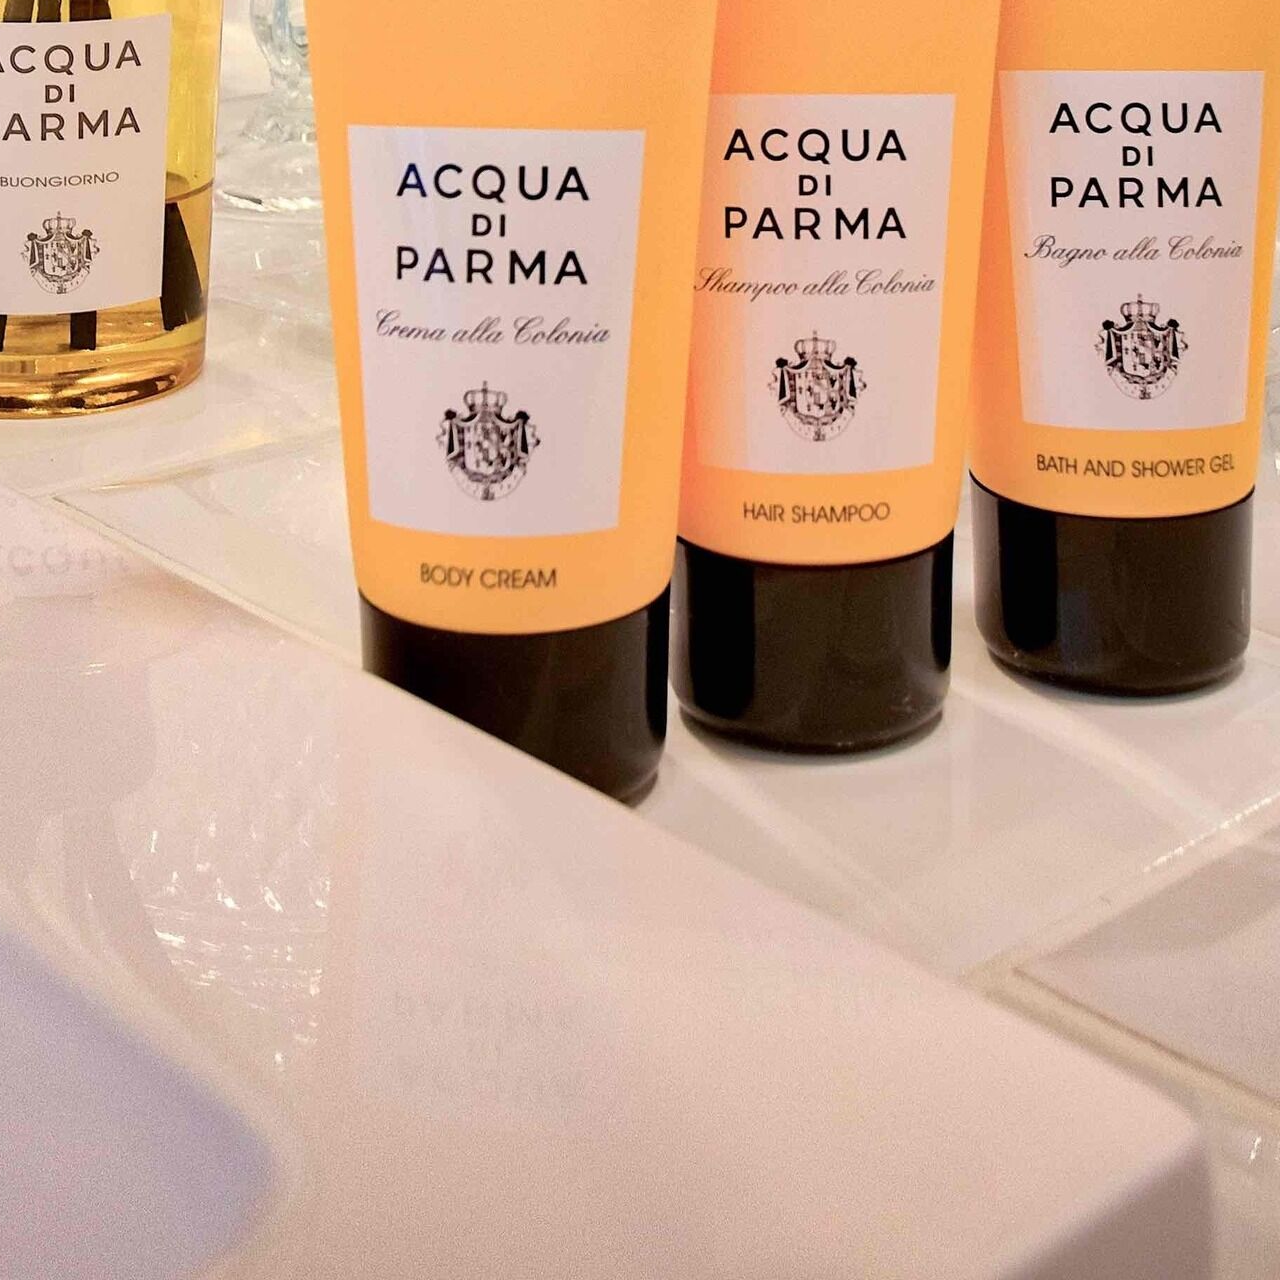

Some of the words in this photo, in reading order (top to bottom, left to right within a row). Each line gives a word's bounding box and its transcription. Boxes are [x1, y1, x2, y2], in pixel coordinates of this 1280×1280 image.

[44, 84, 75, 104] DI
[1049, 102, 1222, 137] ACQUA
[724, 128, 907, 165] ACQUA
[1122, 146, 1153, 166] DI
[0, 171, 120, 190] BUONGIORNO
[396, 163, 589, 203] ACQUA
[798, 174, 831, 196] DI
[1051, 176, 1223, 208] PARMA
[471, 213, 506, 237] DI
[724, 206, 907, 240] PARMA
[396, 246, 588, 285] PARMA
[1024, 234, 1107, 268] Bagno
[1112, 236, 1161, 261] alla
[1167, 235, 1244, 261] Colonia
[694, 267, 798, 302] Shampoo
[801, 269, 851, 296] alla
[855, 269, 936, 295] Colonia
[376, 309, 447, 342] Crema
[451, 316, 504, 345] alla
[513, 317, 610, 345] Colonia
[1036, 453, 1078, 474] BATH
[1083, 459, 1126, 478] AND
[1131, 457, 1206, 479] SHOWER
[1209, 453, 1235, 474] GEL
[743, 501, 785, 523] HAIR
[791, 501, 891, 524] SHAMPOO
[420, 562, 474, 588] BODY
[479, 568, 558, 591] CREAM
